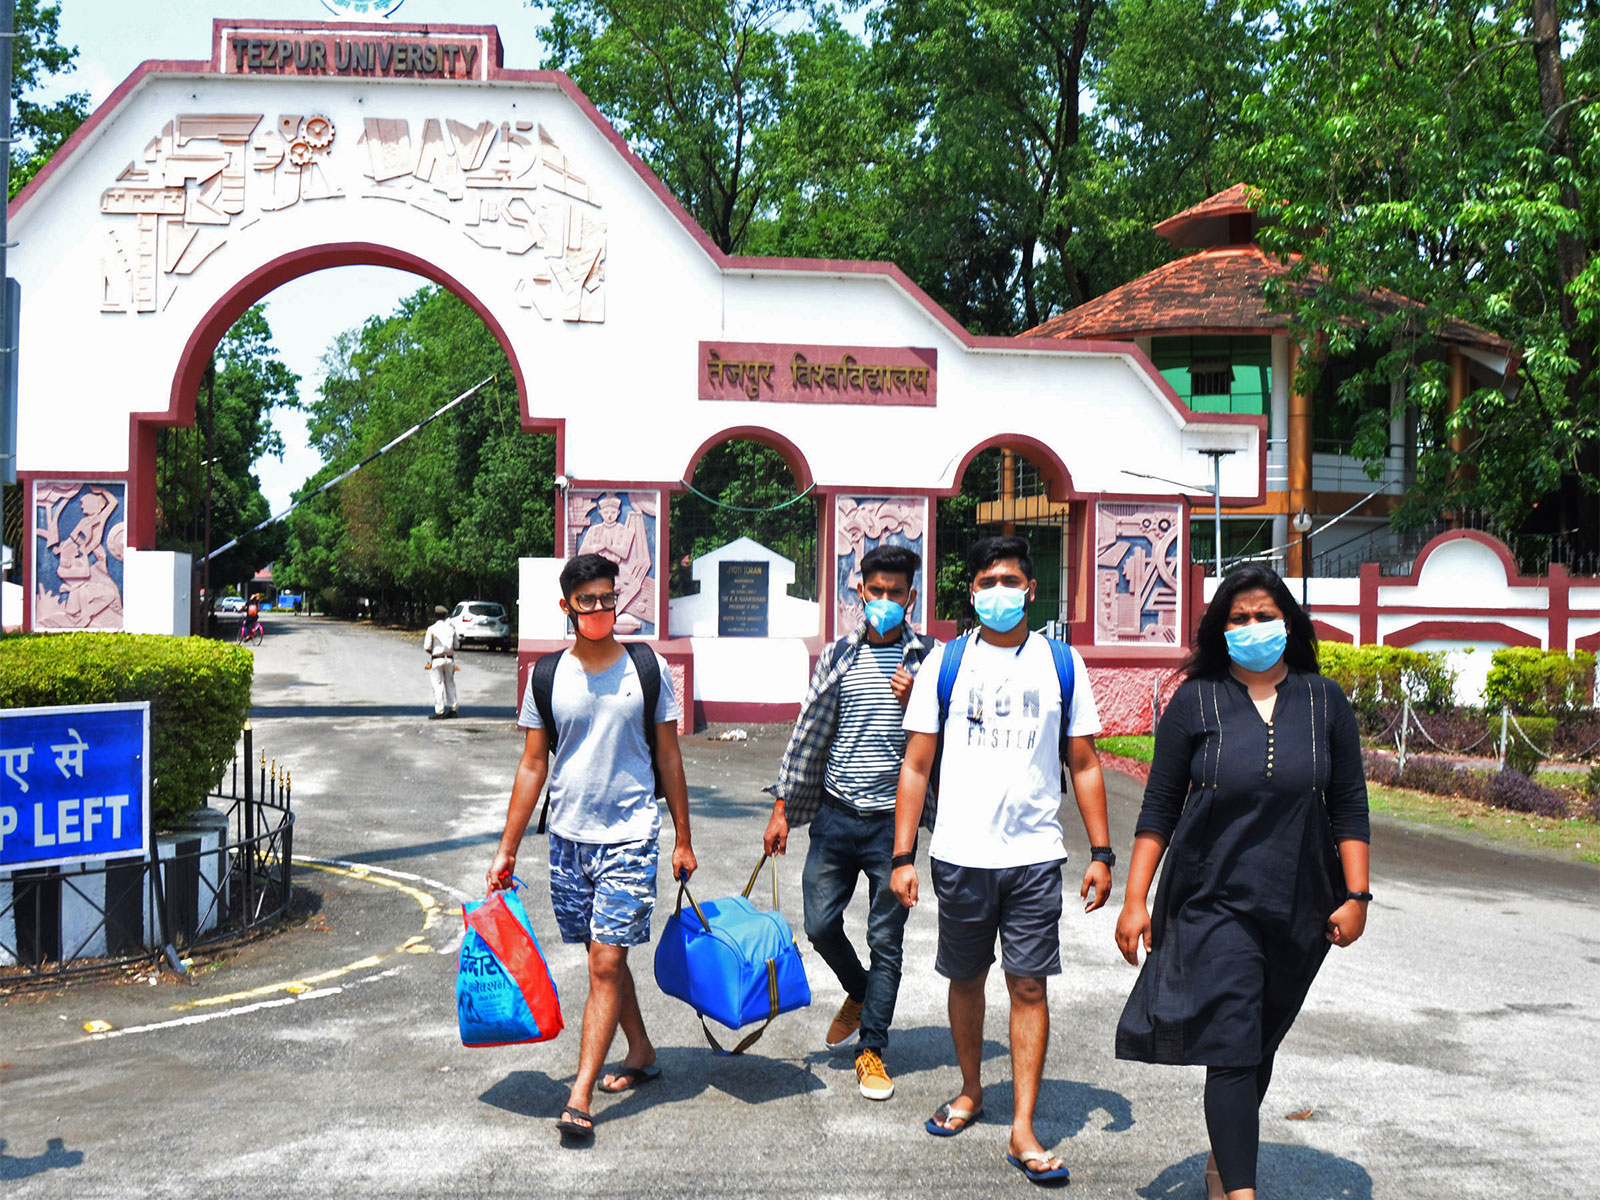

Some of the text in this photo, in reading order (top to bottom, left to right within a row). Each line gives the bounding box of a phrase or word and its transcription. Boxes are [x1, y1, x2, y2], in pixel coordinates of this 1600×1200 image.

[233, 38, 477, 73] TEZPUR UNIVERSITY
[707, 348, 929, 398] तेजपुर विश्वविद्यालय
[51, 728, 89, 779] से
[34, 795, 129, 847] LEFT
